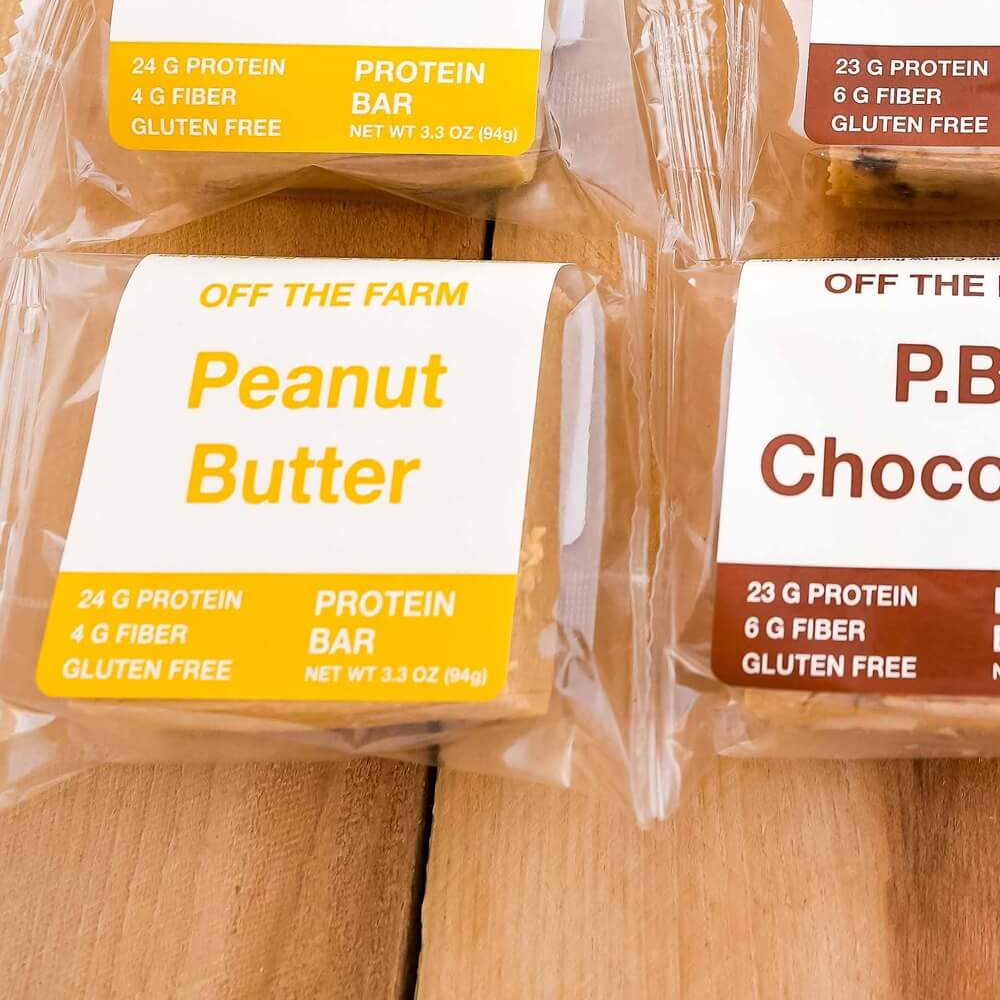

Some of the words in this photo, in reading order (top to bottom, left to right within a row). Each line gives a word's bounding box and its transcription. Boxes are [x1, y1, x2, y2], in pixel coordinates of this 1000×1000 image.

[354, 59, 486, 85] PROTEIN
[835, 58, 860, 75] 23
[867, 59, 883, 76] G
[890, 59, 988, 77] PROTEIN
[351, 91, 413, 116] BAR
[833, 86, 846, 103] 6
[852, 86, 869, 104] G
[876, 87, 942, 105] FIBER
[131, 117, 218, 136] GLUTEN
[224, 118, 282, 137] FREE
[831, 114, 923, 133] GLUTEN
[930, 116, 989, 133] FREE
[199, 283, 273, 308] OFF
[284, 282, 354, 308] THE
[363, 281, 469, 307] FARM
[824, 273, 899, 295] OFF
[909, 274, 985, 297] THE
[187, 351, 447, 410] Peanut
[186, 442, 422, 505] Butter
[77, 588, 105, 609] 24
[111, 588, 130, 610] G
[136, 588, 243, 611] PROTEIN
[315, 589, 456, 618] PROTEIN
[308, 627, 376, 655] BAR
[62, 657, 163, 680] GLUTEN
[168, 659, 233, 681] FREE
[304, 665, 342, 683] NET
[347, 665, 377, 682] WT
[381, 666, 409, 683] 3.3
[412, 666, 439, 684] OZ
[443, 666, 488, 688] (94g)
[742, 652, 845, 678] GLUTEN
[852, 655, 917, 679] FREE
